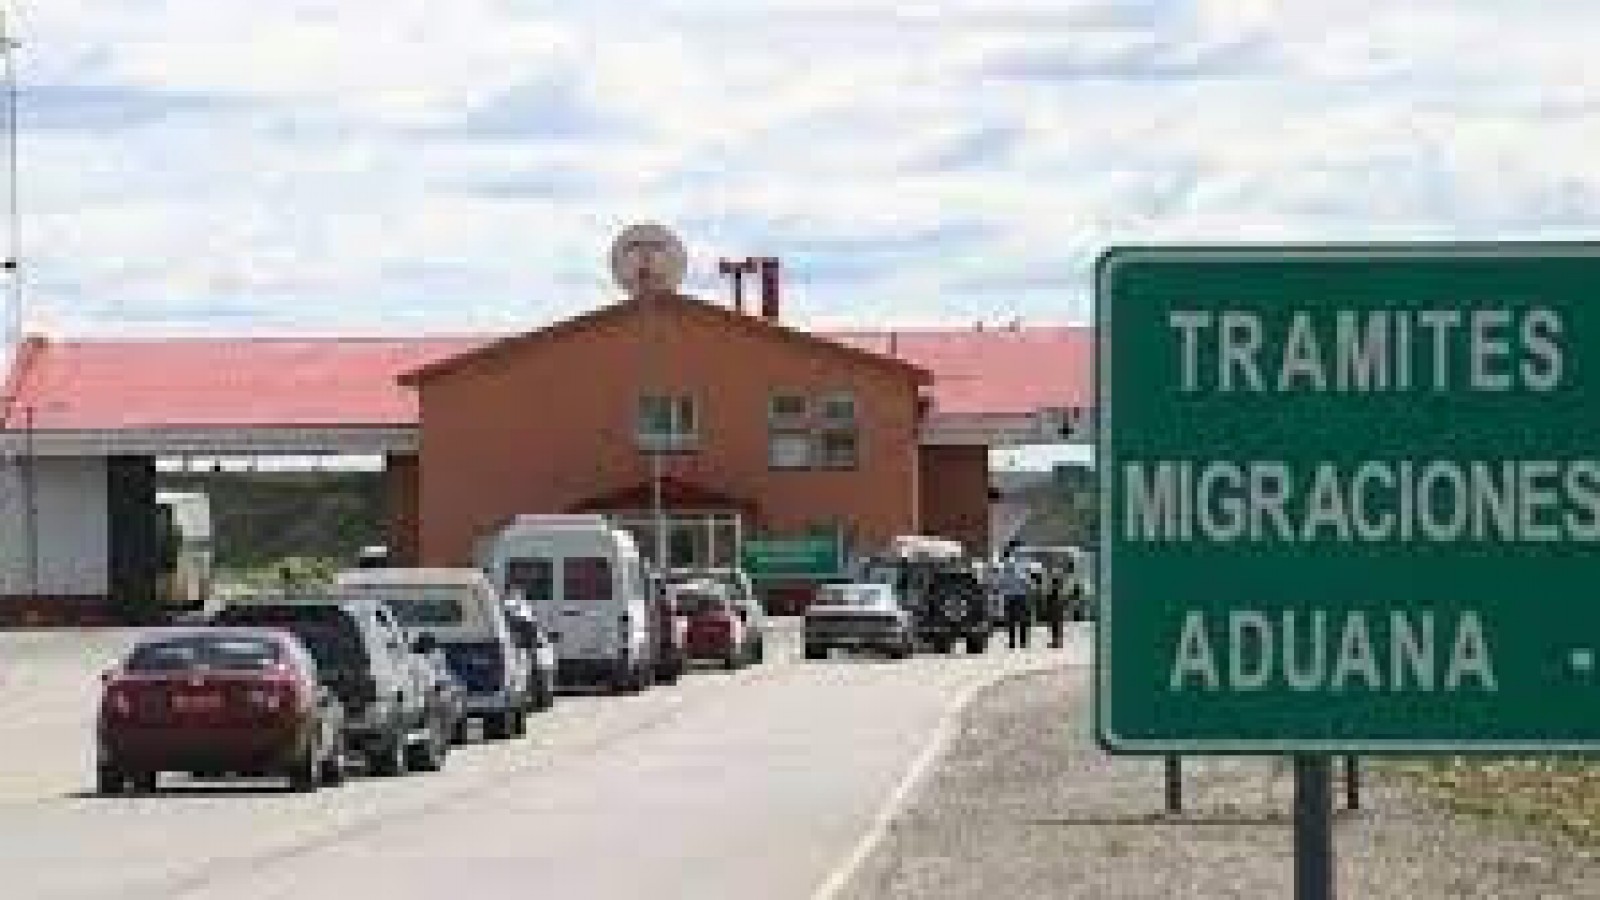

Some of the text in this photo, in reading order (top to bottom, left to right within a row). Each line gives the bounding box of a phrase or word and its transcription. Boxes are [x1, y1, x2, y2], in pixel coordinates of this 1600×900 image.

[1170, 310, 1563, 391] TRAMITES
[1122, 460, 1600, 541] MIGRACIONES
[1170, 611, 1499, 691] ADUANA
